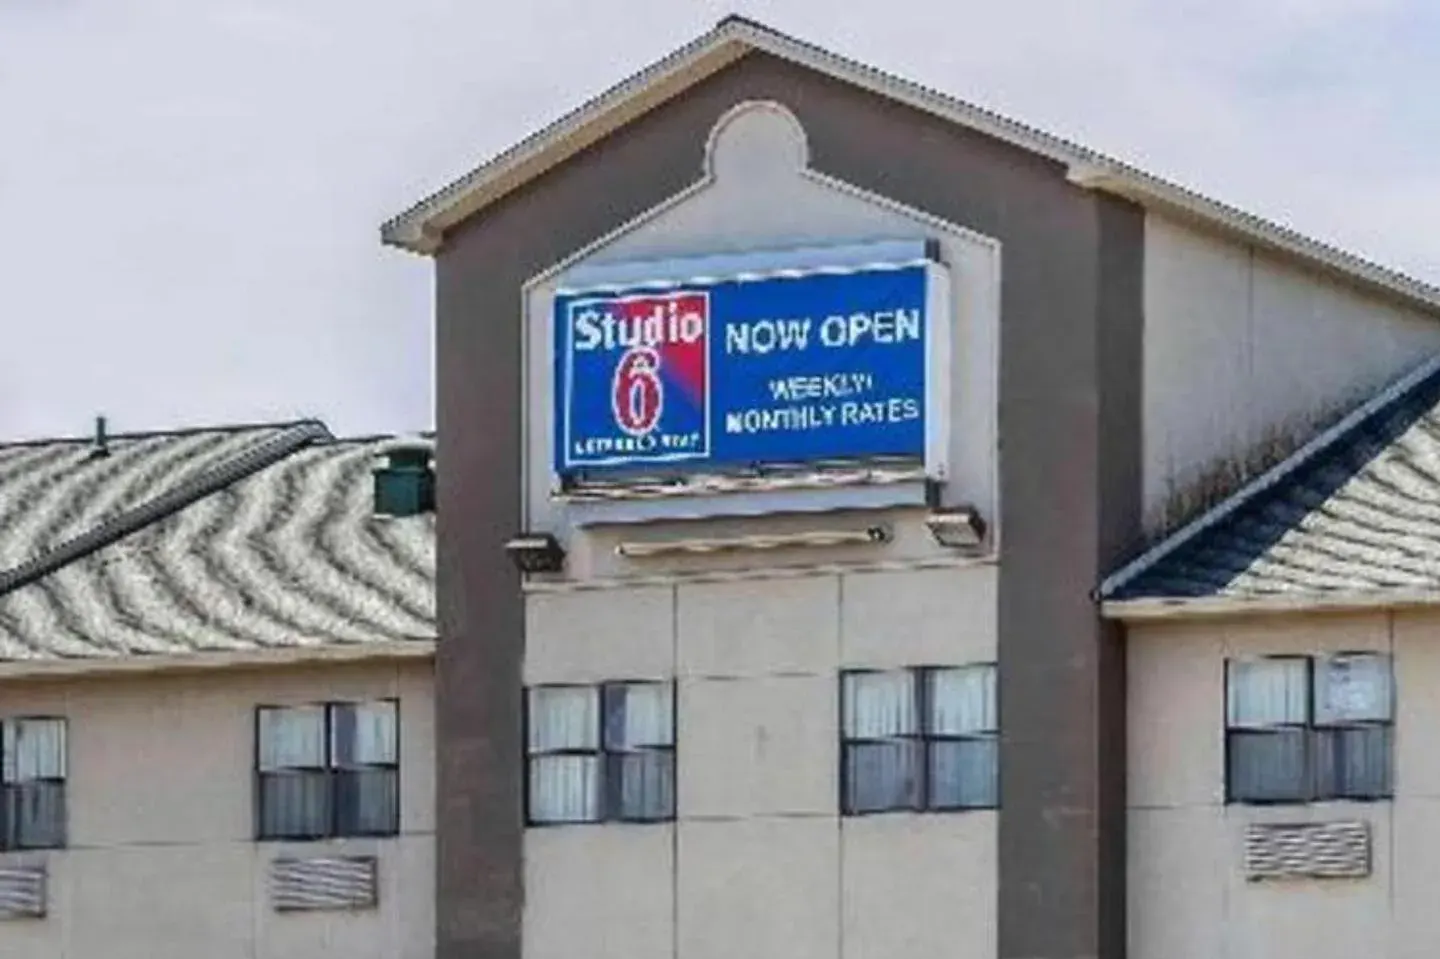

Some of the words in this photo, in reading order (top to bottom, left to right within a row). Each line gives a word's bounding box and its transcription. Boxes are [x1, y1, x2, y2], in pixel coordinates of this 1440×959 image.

[575, 303, 703, 350] Studio
[725, 318, 812, 354] NOW
[821, 308, 920, 346] OPEN
[613, 347, 662, 435] 6
[726, 406, 836, 433] MONTHLY
[842, 399, 919, 426] RATES
